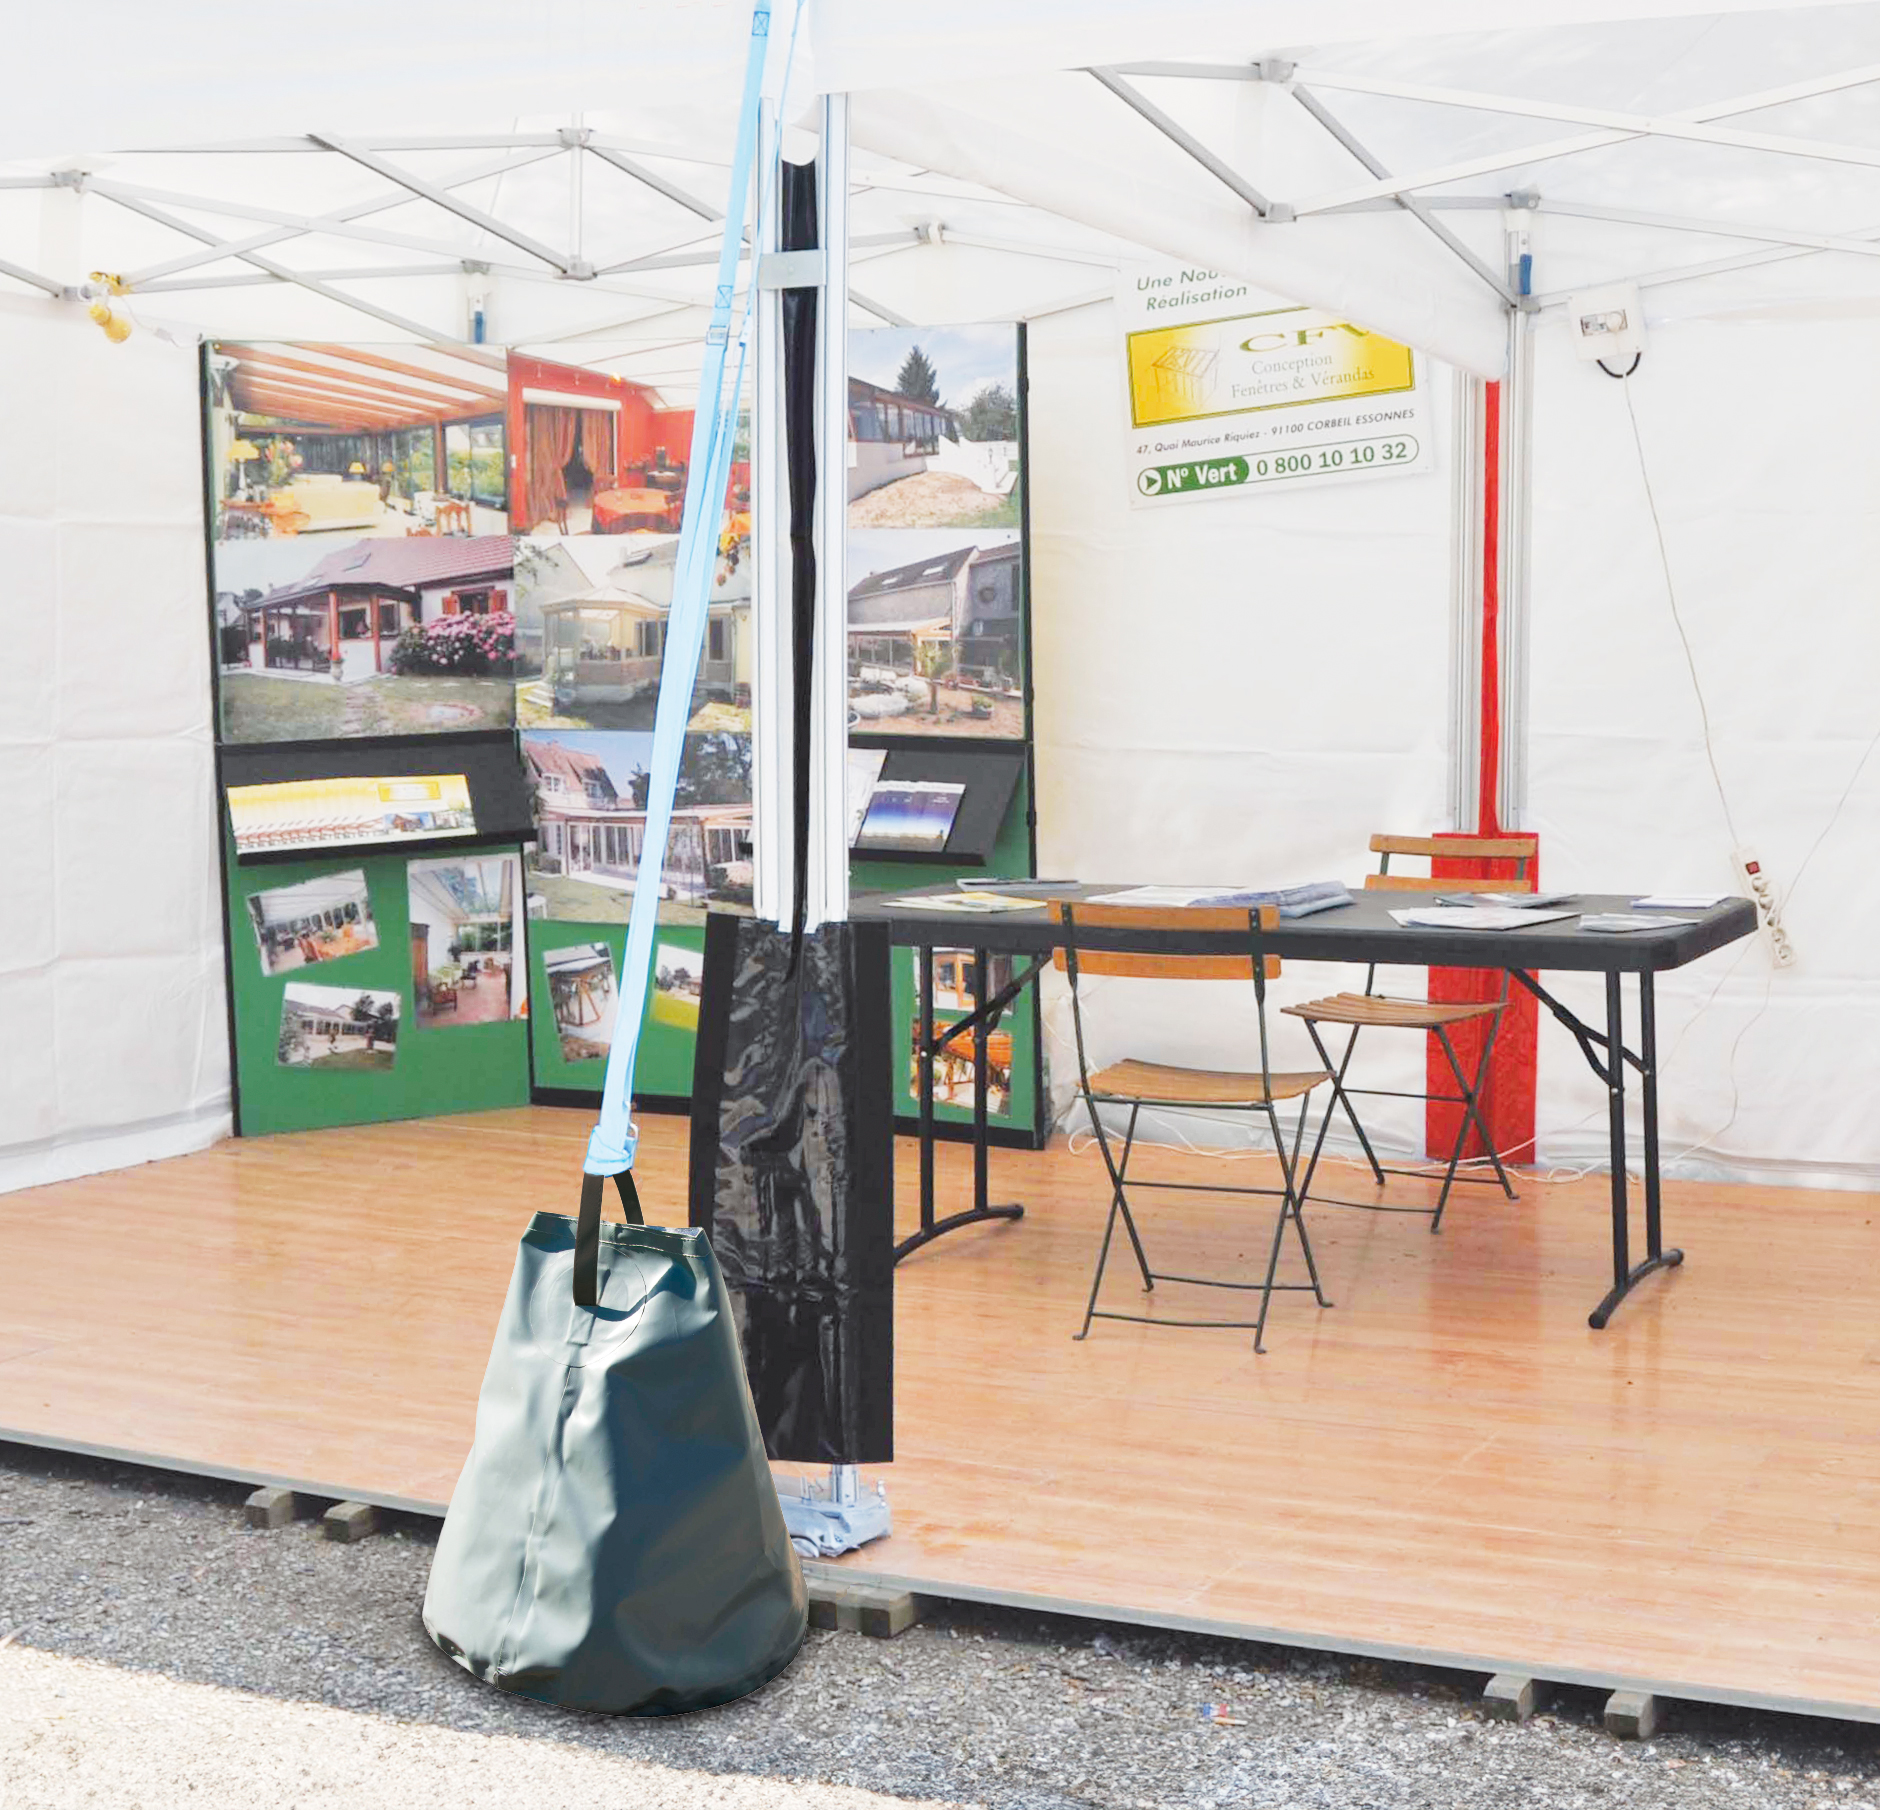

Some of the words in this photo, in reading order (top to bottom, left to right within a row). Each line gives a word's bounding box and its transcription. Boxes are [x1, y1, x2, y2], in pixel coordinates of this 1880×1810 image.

[1137, 276, 1172, 291] Une
[1180, 269, 1225, 284] Nou
[1146, 286, 1247, 311] Réalisation
[1252, 355, 1333, 374] Conception
[1231, 380, 1288, 398] Fenêtres
[1293, 375, 1304, 390] &
[1311, 366, 1375, 386] Vérandas
[1154, 440, 1179, 452] Quai
[1181, 436, 1221, 448] Maurice
[1224, 430, 1260, 442] Riquiez
[1271, 423, 1304, 435] 91100
[1307, 417, 1352, 431] CORBEIL
[1355, 408, 1415, 425] ESSONNES
[1195, 461, 1238, 484] Vert
[1256, 460, 1268, 476] 0
[1274, 454, 1312, 474] 800
[1319, 449, 1343, 468] 10
[1350, 445, 1375, 464] 10
[1382, 442, 1407, 460] 32
